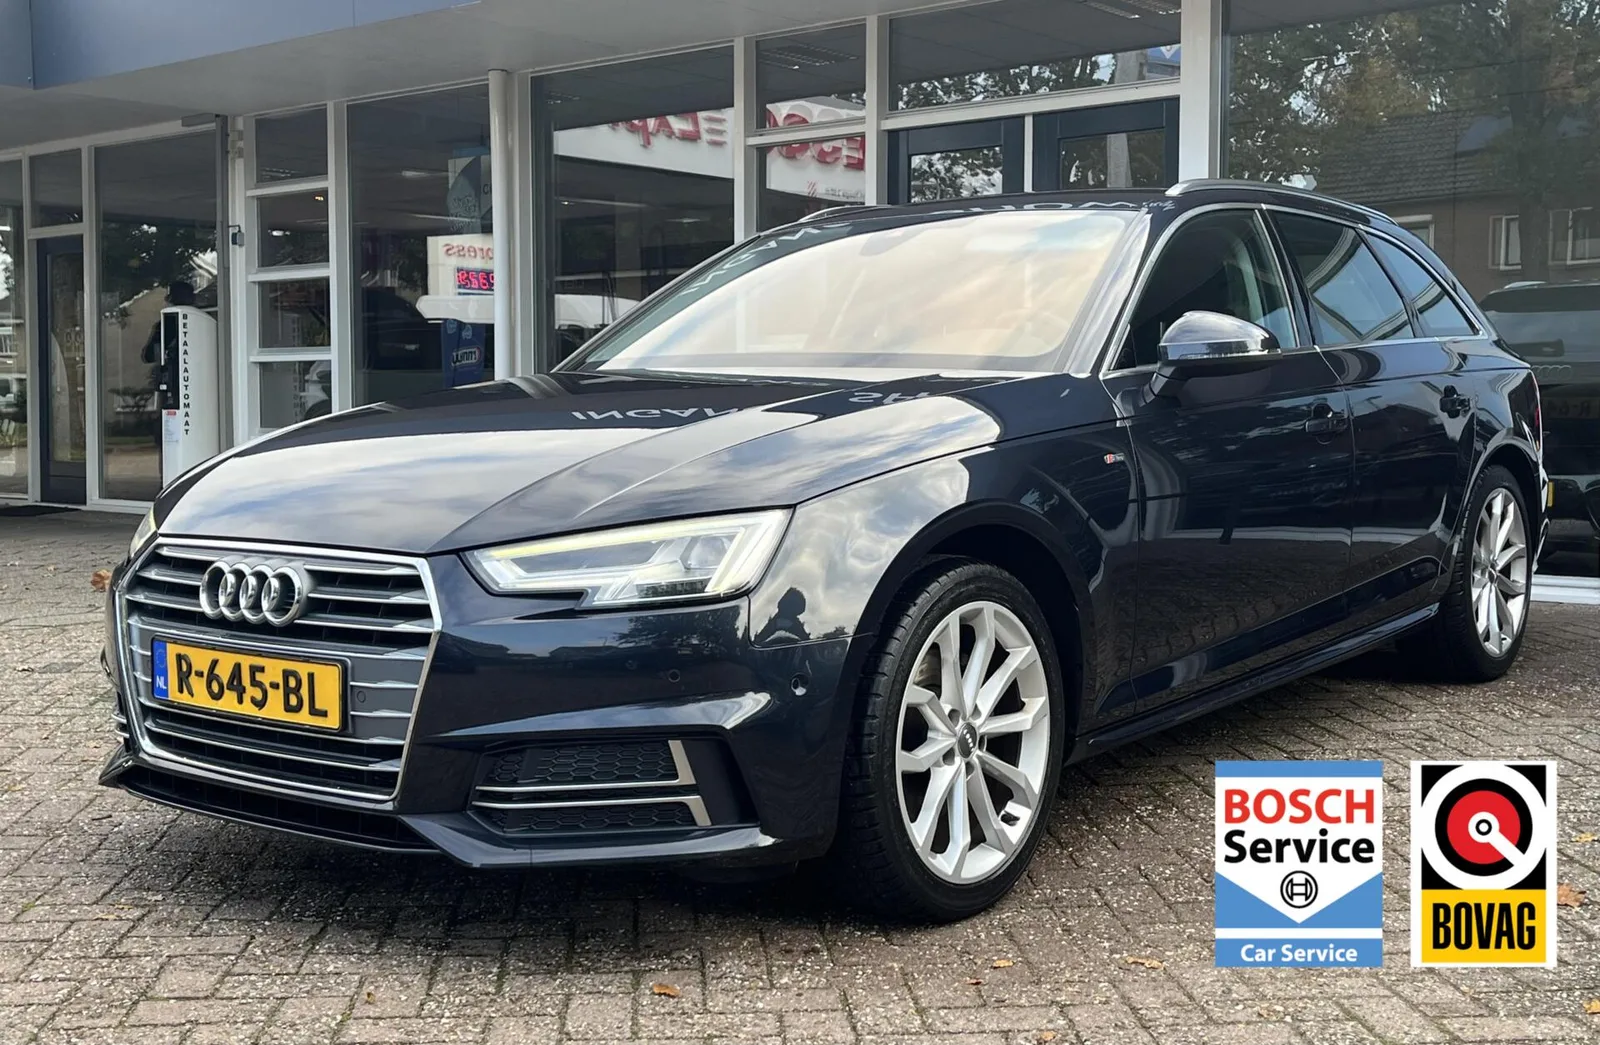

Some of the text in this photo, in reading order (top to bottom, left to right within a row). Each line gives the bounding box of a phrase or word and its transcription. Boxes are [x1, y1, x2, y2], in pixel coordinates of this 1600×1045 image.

[182, 313, 190, 435] BETAALAUTOMAAT
[156, 675, 168, 690] NL
[175, 652, 328, 718] R-645-BL
